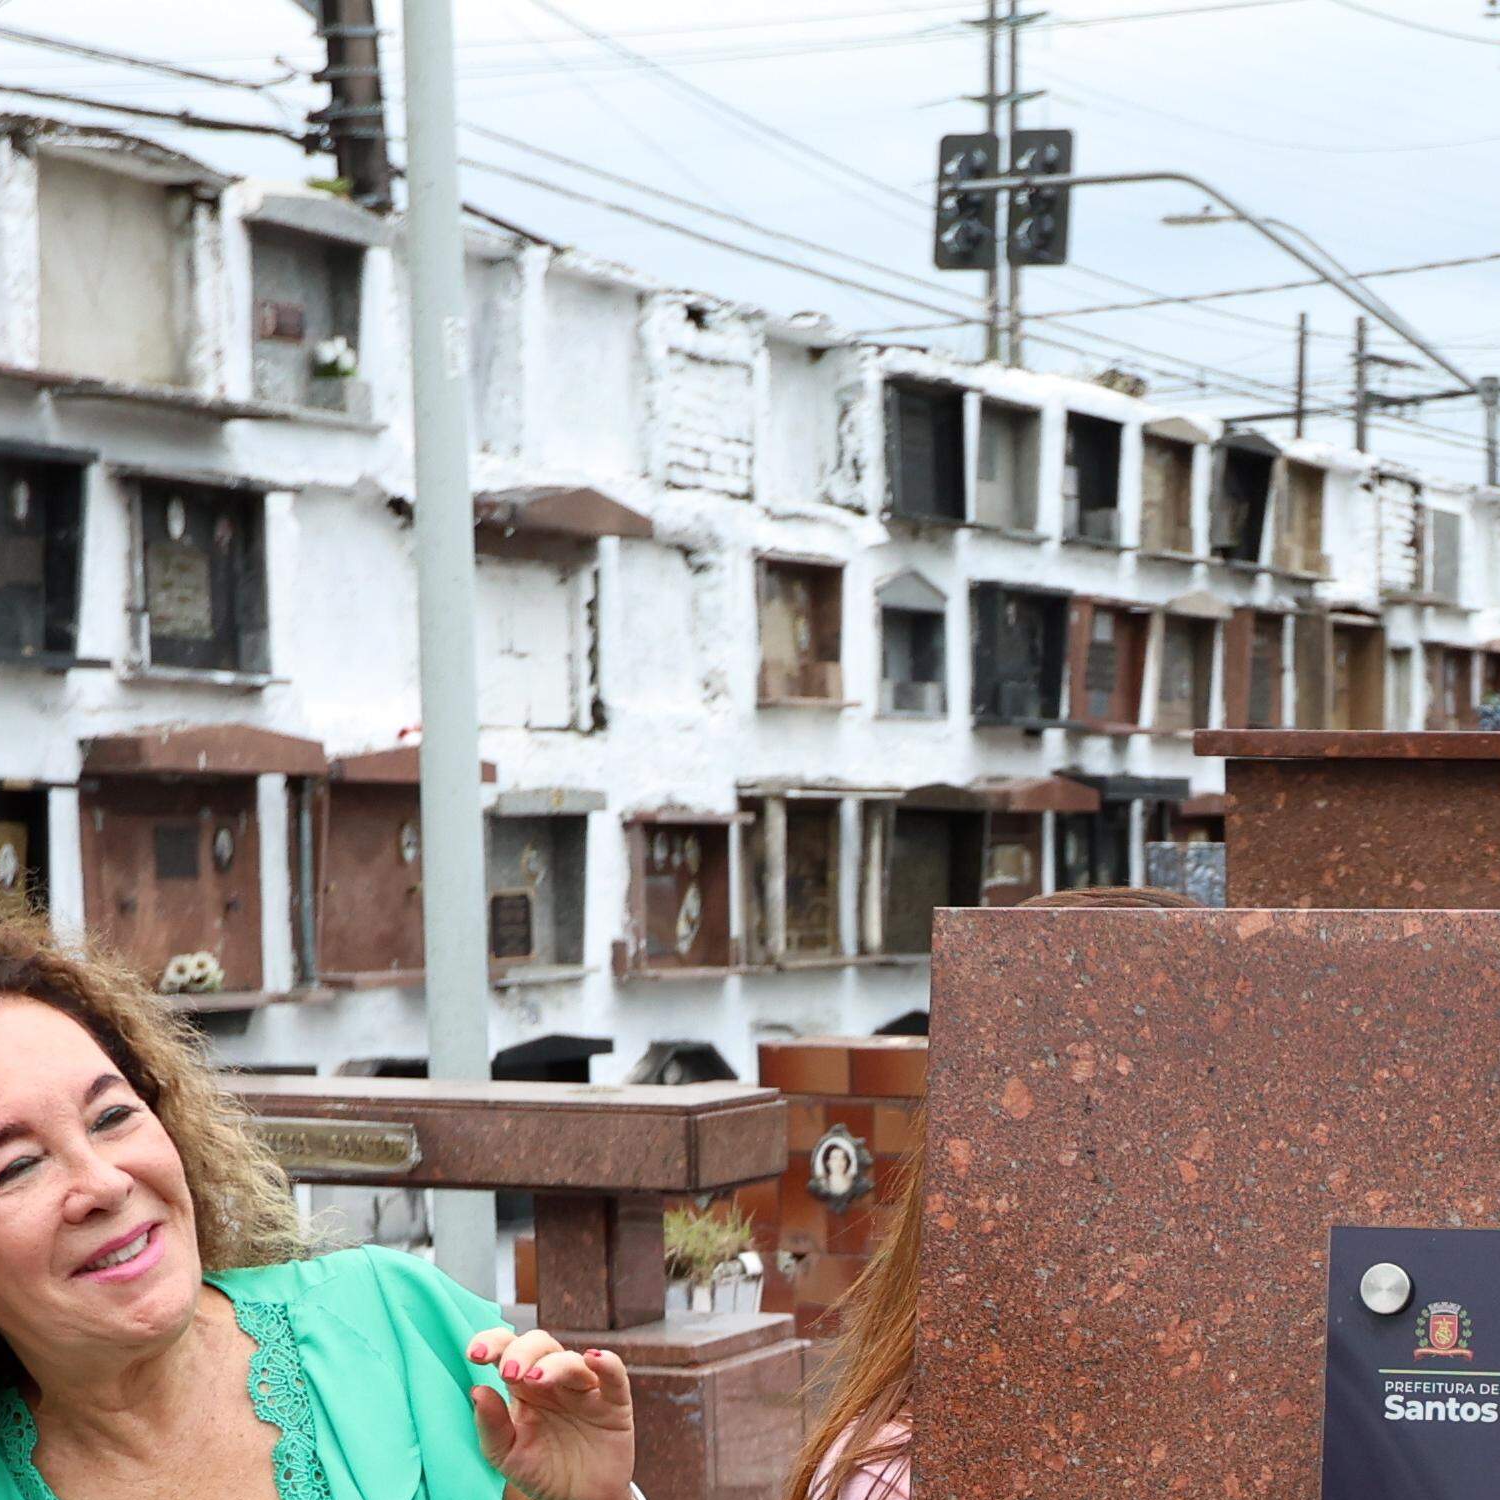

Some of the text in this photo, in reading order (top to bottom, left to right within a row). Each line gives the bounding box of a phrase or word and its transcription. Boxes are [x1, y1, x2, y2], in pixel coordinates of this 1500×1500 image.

[1384, 1380, 1500, 1395] PREFEITURA DE
[1384, 1394, 1499, 1423] Santos
